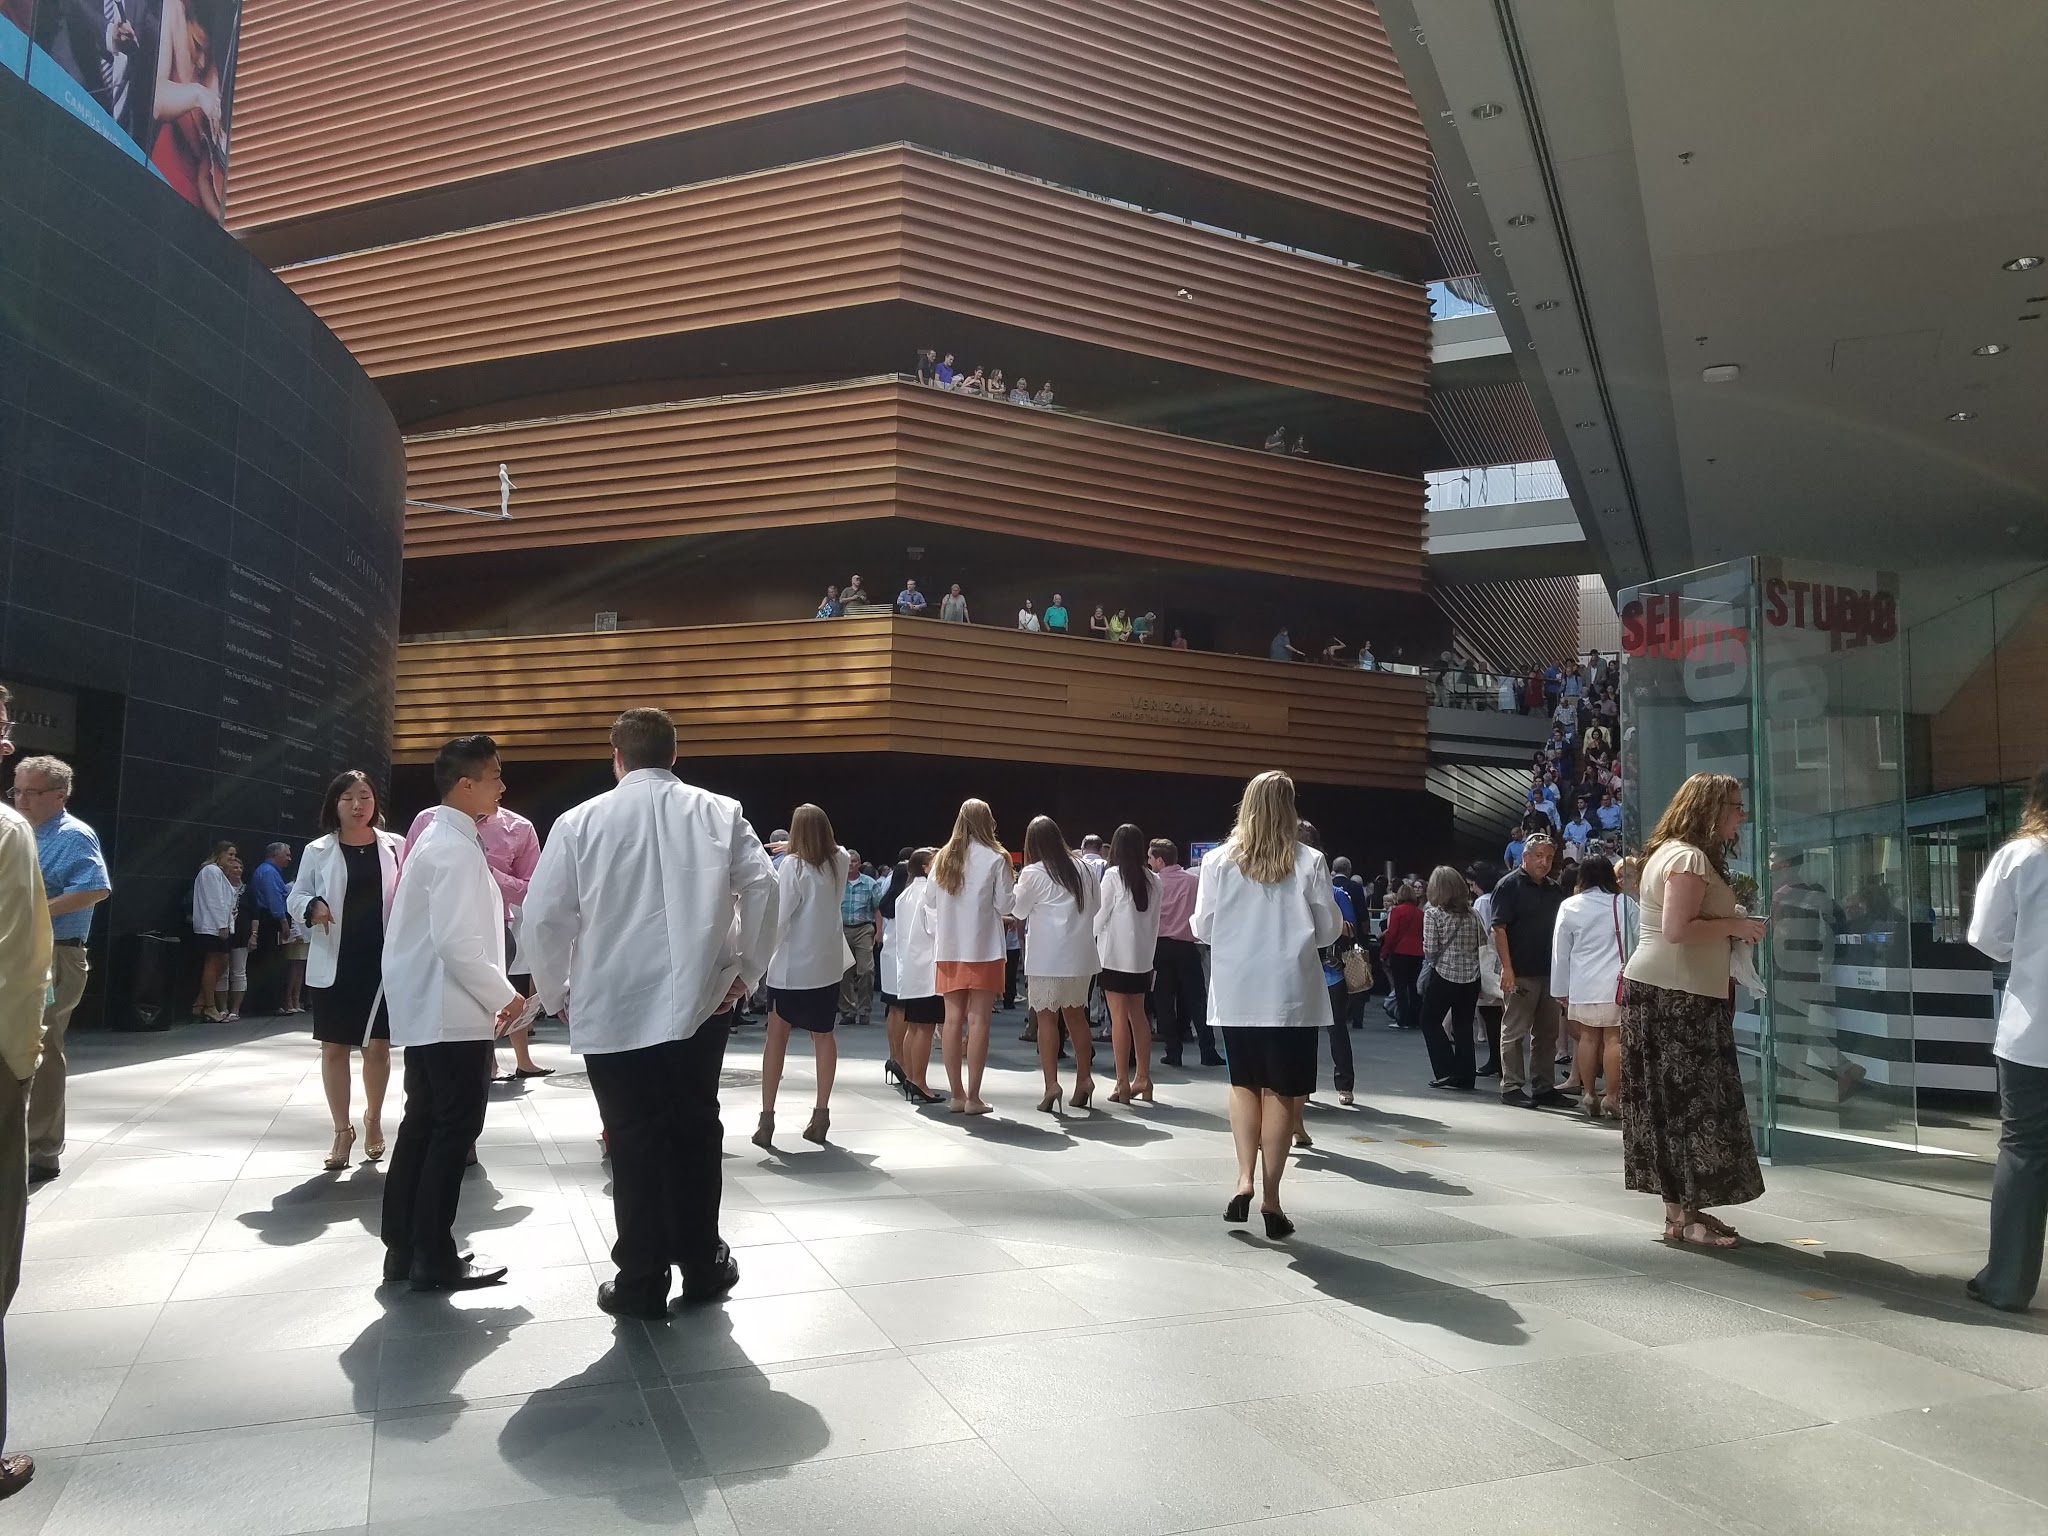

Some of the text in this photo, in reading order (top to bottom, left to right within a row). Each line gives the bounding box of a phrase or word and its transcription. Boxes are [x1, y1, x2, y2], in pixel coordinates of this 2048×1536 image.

[1622, 592, 1680, 651] SEI
[1130, 695, 1231, 718] VERIZON HALL
